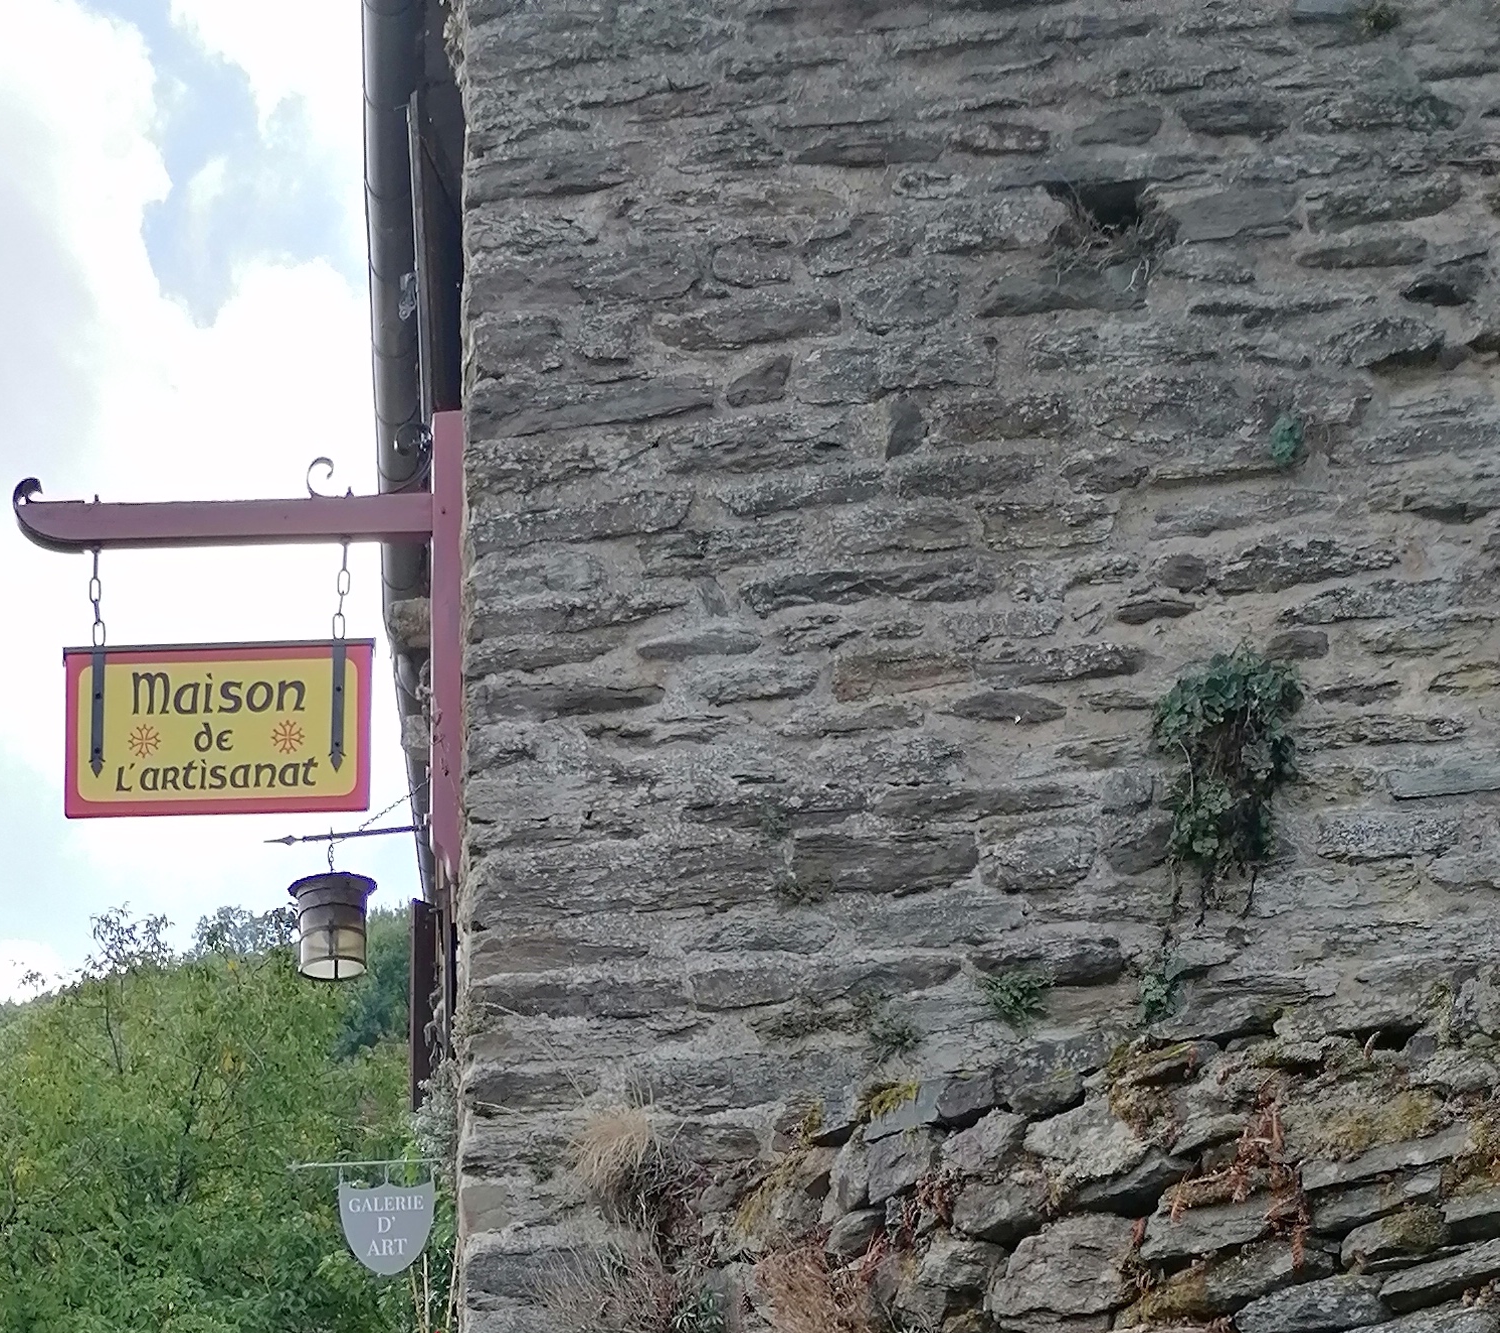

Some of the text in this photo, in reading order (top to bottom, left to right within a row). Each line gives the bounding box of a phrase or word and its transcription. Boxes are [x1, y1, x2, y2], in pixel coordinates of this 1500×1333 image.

[132, 672, 306, 715] Maison
[194, 722, 234, 752] de
[348, 1195, 424, 1213] GALERIE
[377, 1217, 396, 1234] D'
[366, 1238, 408, 1257] ART
